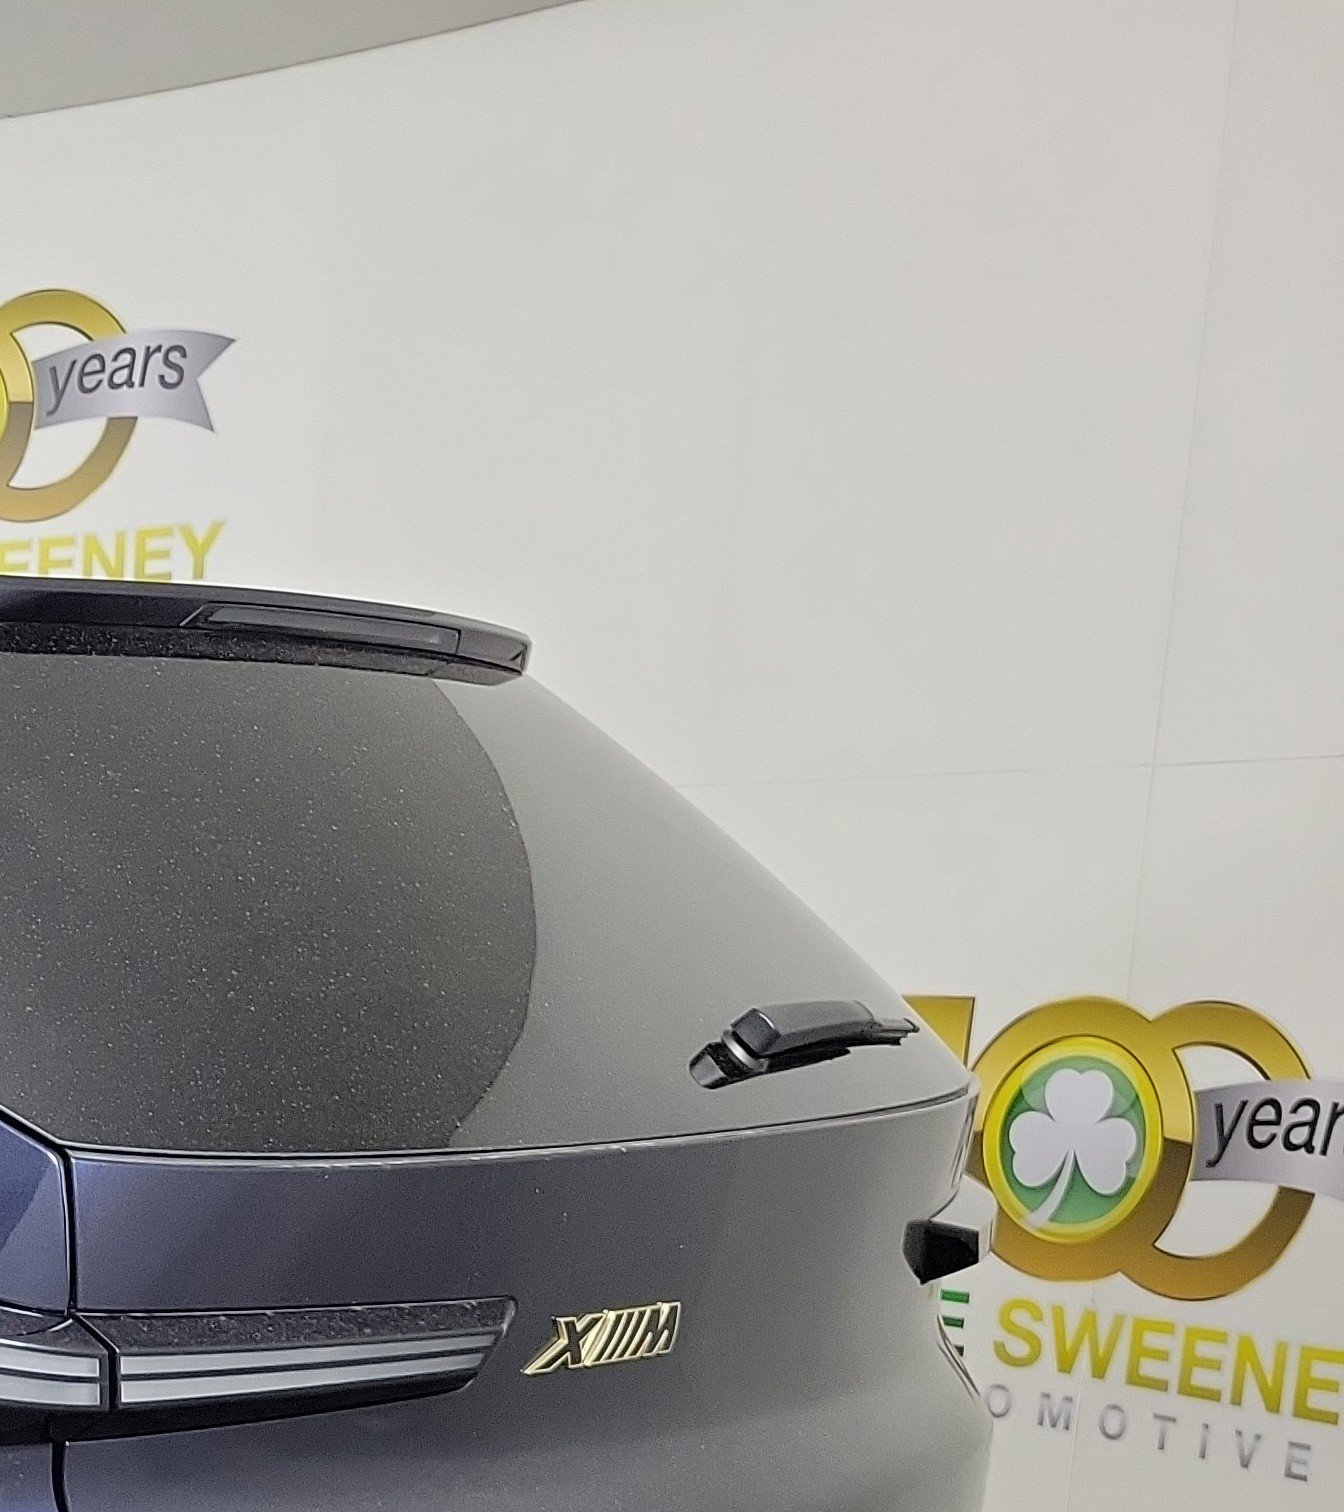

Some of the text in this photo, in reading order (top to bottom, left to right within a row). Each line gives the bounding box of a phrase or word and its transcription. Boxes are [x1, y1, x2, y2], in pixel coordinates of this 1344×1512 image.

[47, 340, 188, 416] years
[1205, 1096, 1344, 1168] year
[992, 1296, 1344, 1427] SWEENE
[986, 1382, 1312, 1482] OMOTIVE
